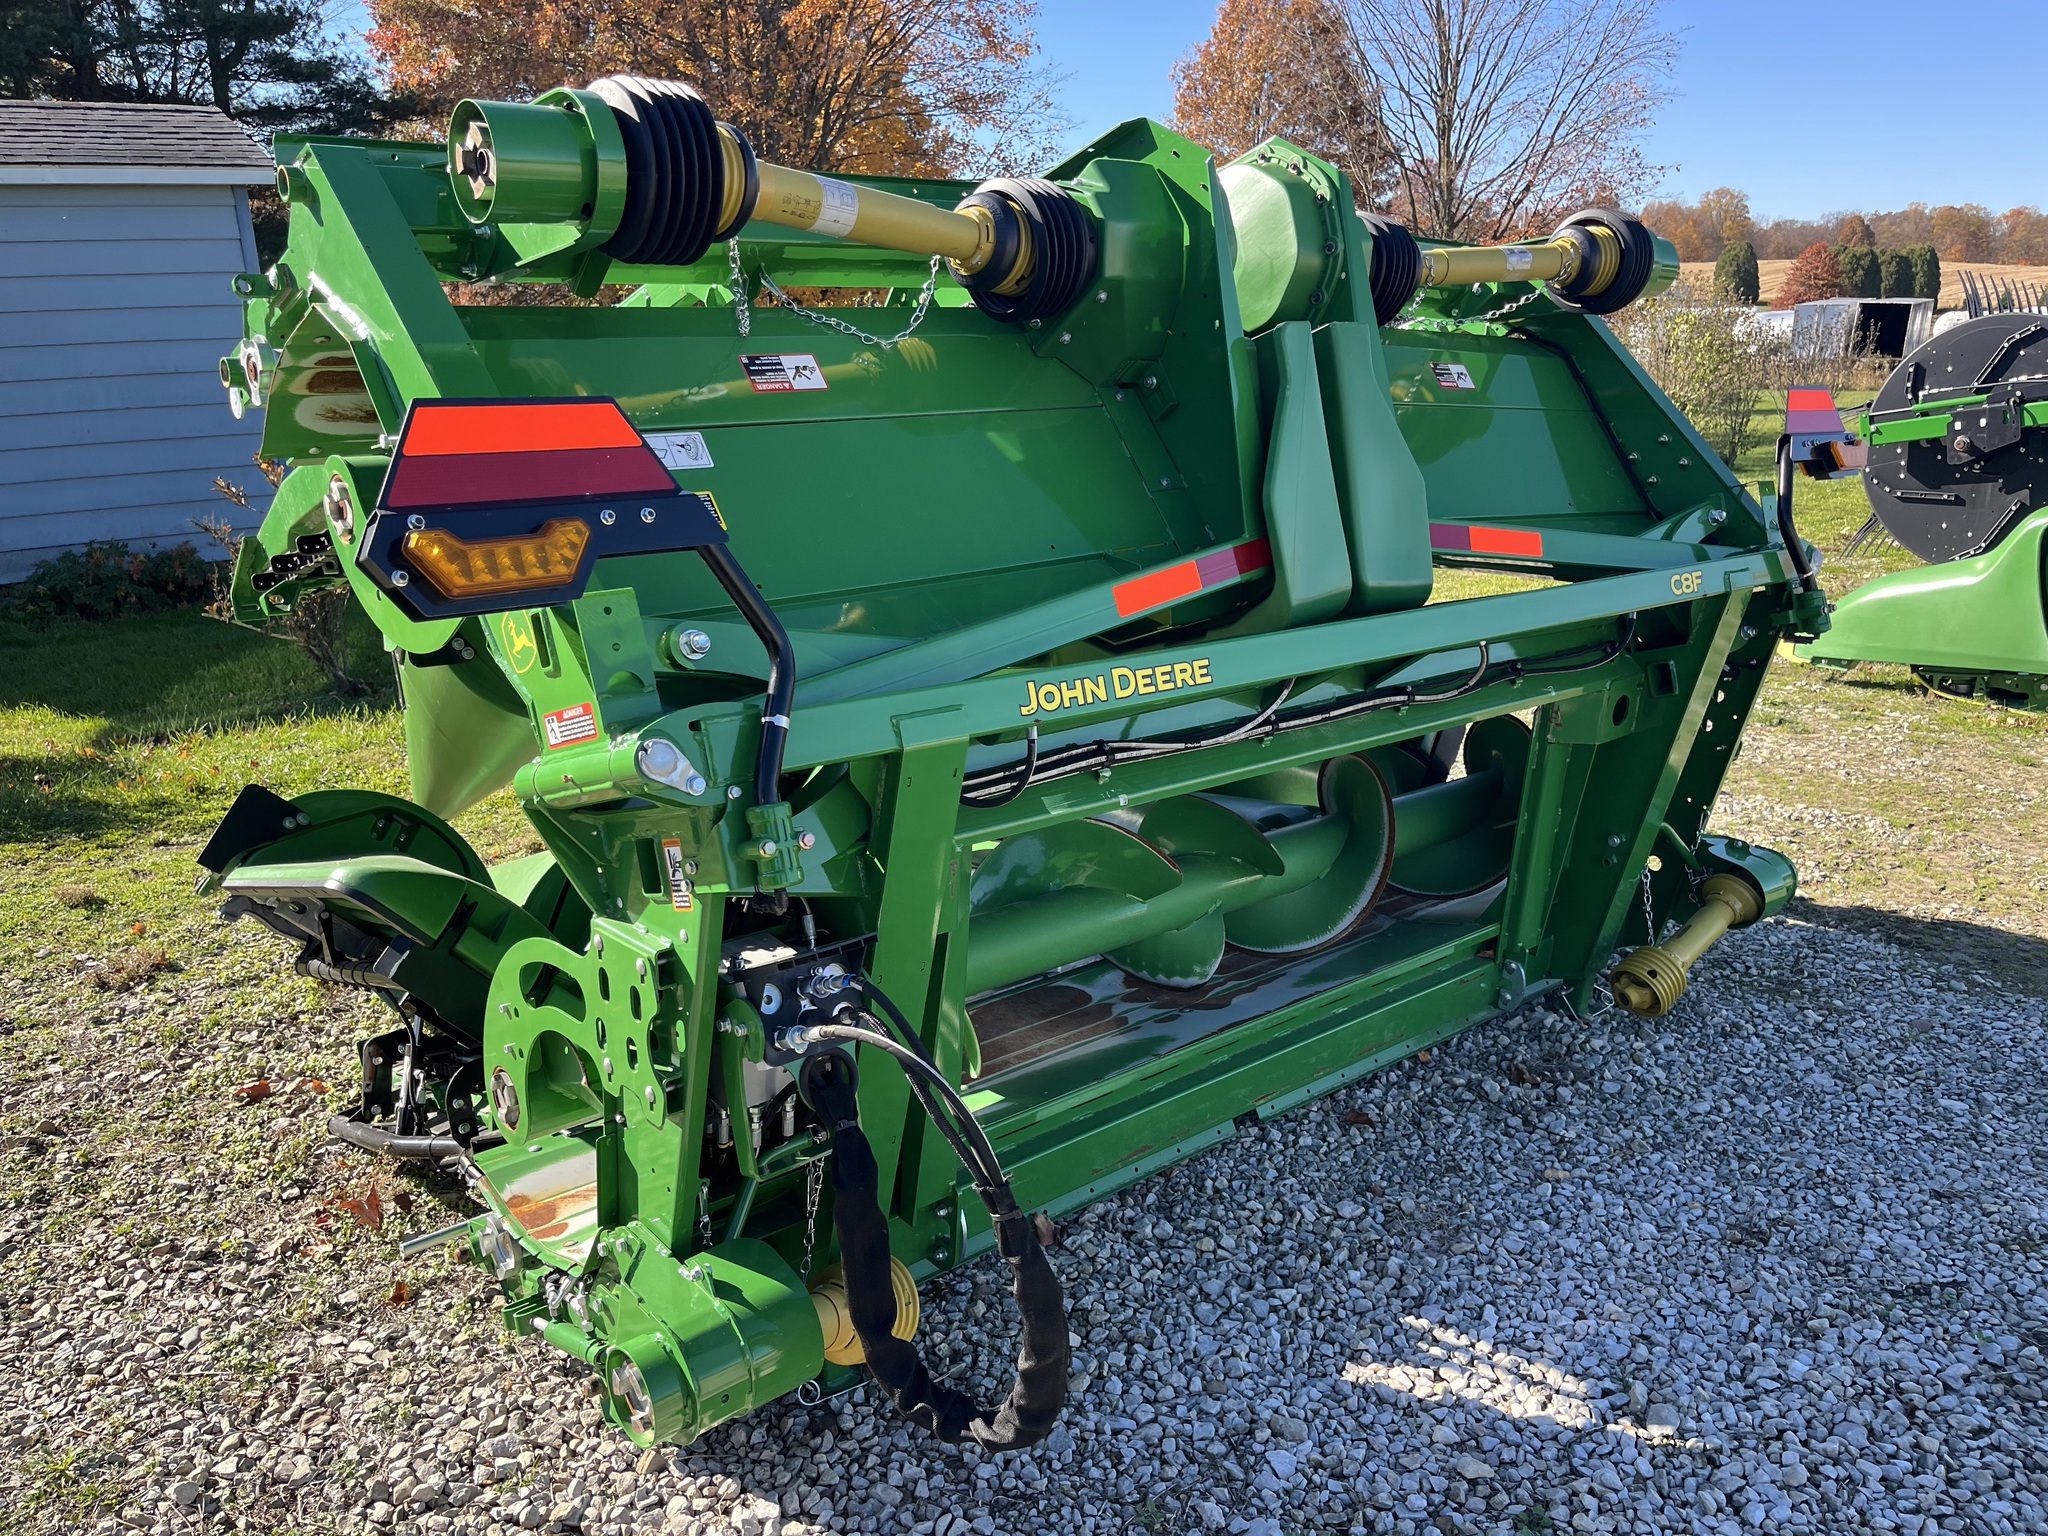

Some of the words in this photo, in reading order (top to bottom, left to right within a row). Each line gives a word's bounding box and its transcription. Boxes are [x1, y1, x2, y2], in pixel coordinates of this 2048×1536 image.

[1670, 570, 1702, 596] C8F
[1019, 675, 1108, 716] JOHN
[1110, 658, 1212, 699] DEERE
